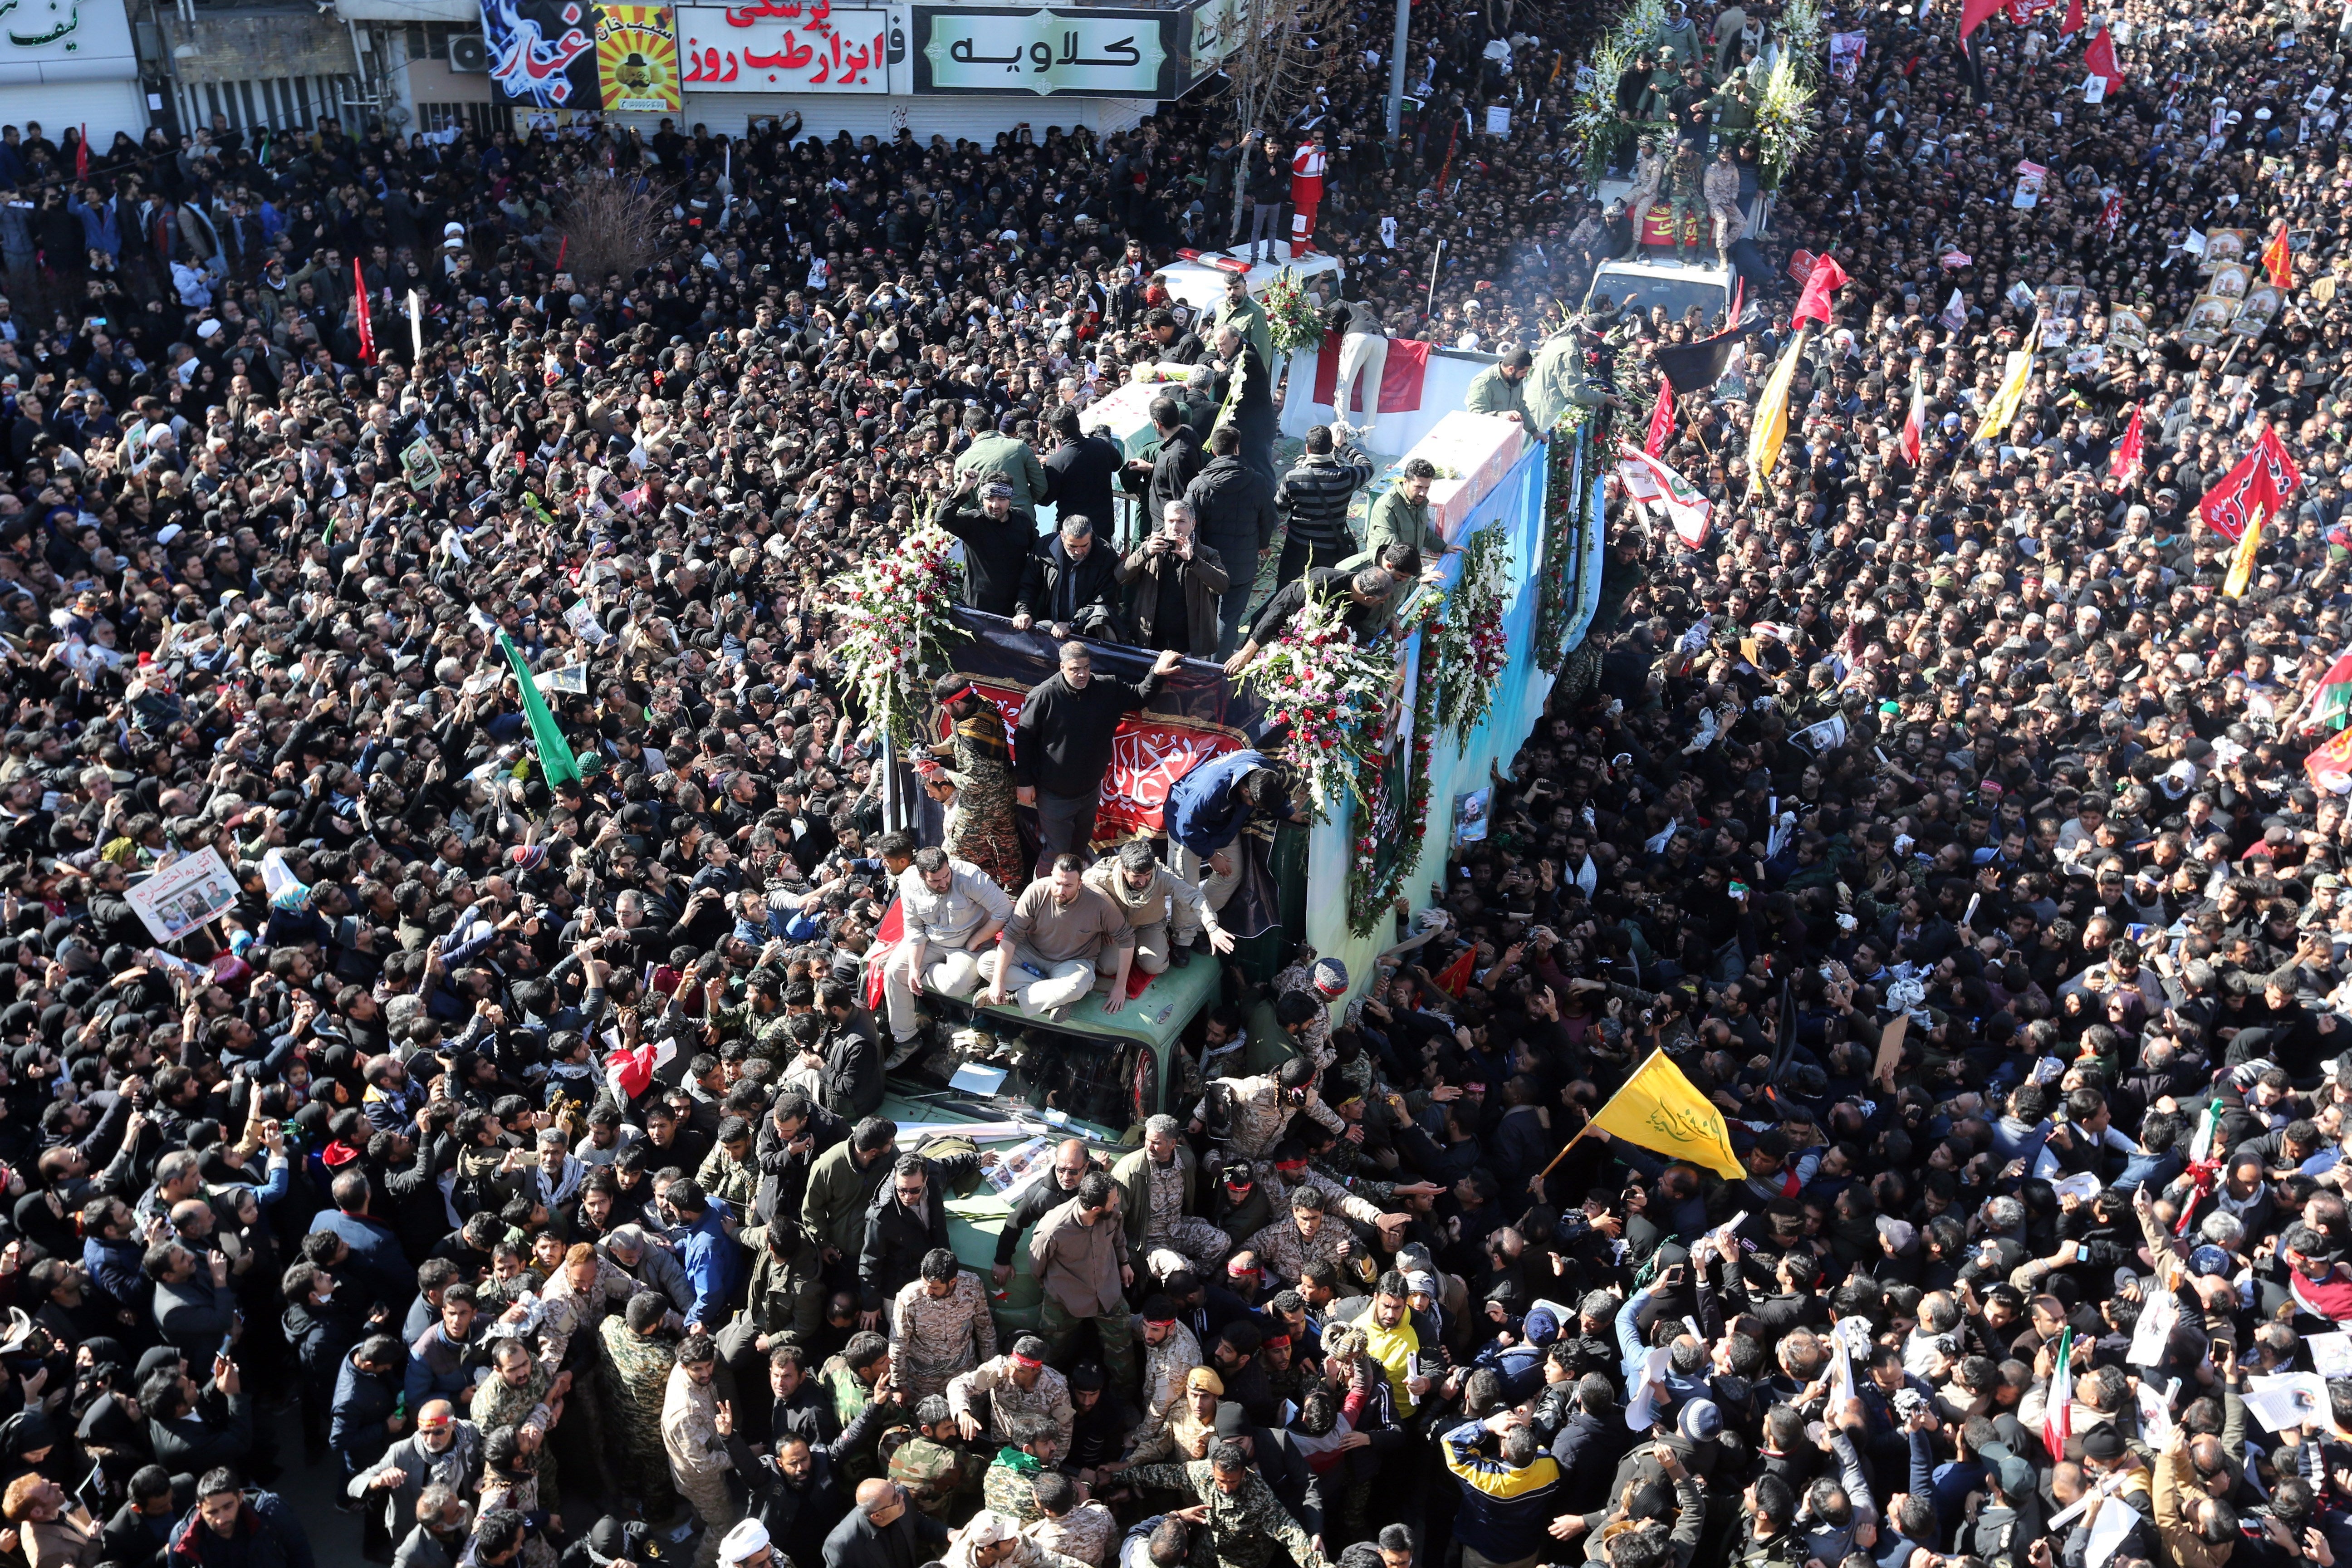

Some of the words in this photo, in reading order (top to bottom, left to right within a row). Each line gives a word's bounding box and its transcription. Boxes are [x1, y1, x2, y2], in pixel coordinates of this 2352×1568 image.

[494, 5, 591, 101] غبار
[597, 17, 625, 42] خان
[744, 29, 814, 83] طب
[682, 36, 740, 83] روز
[809, 30, 885, 85] ابزار
